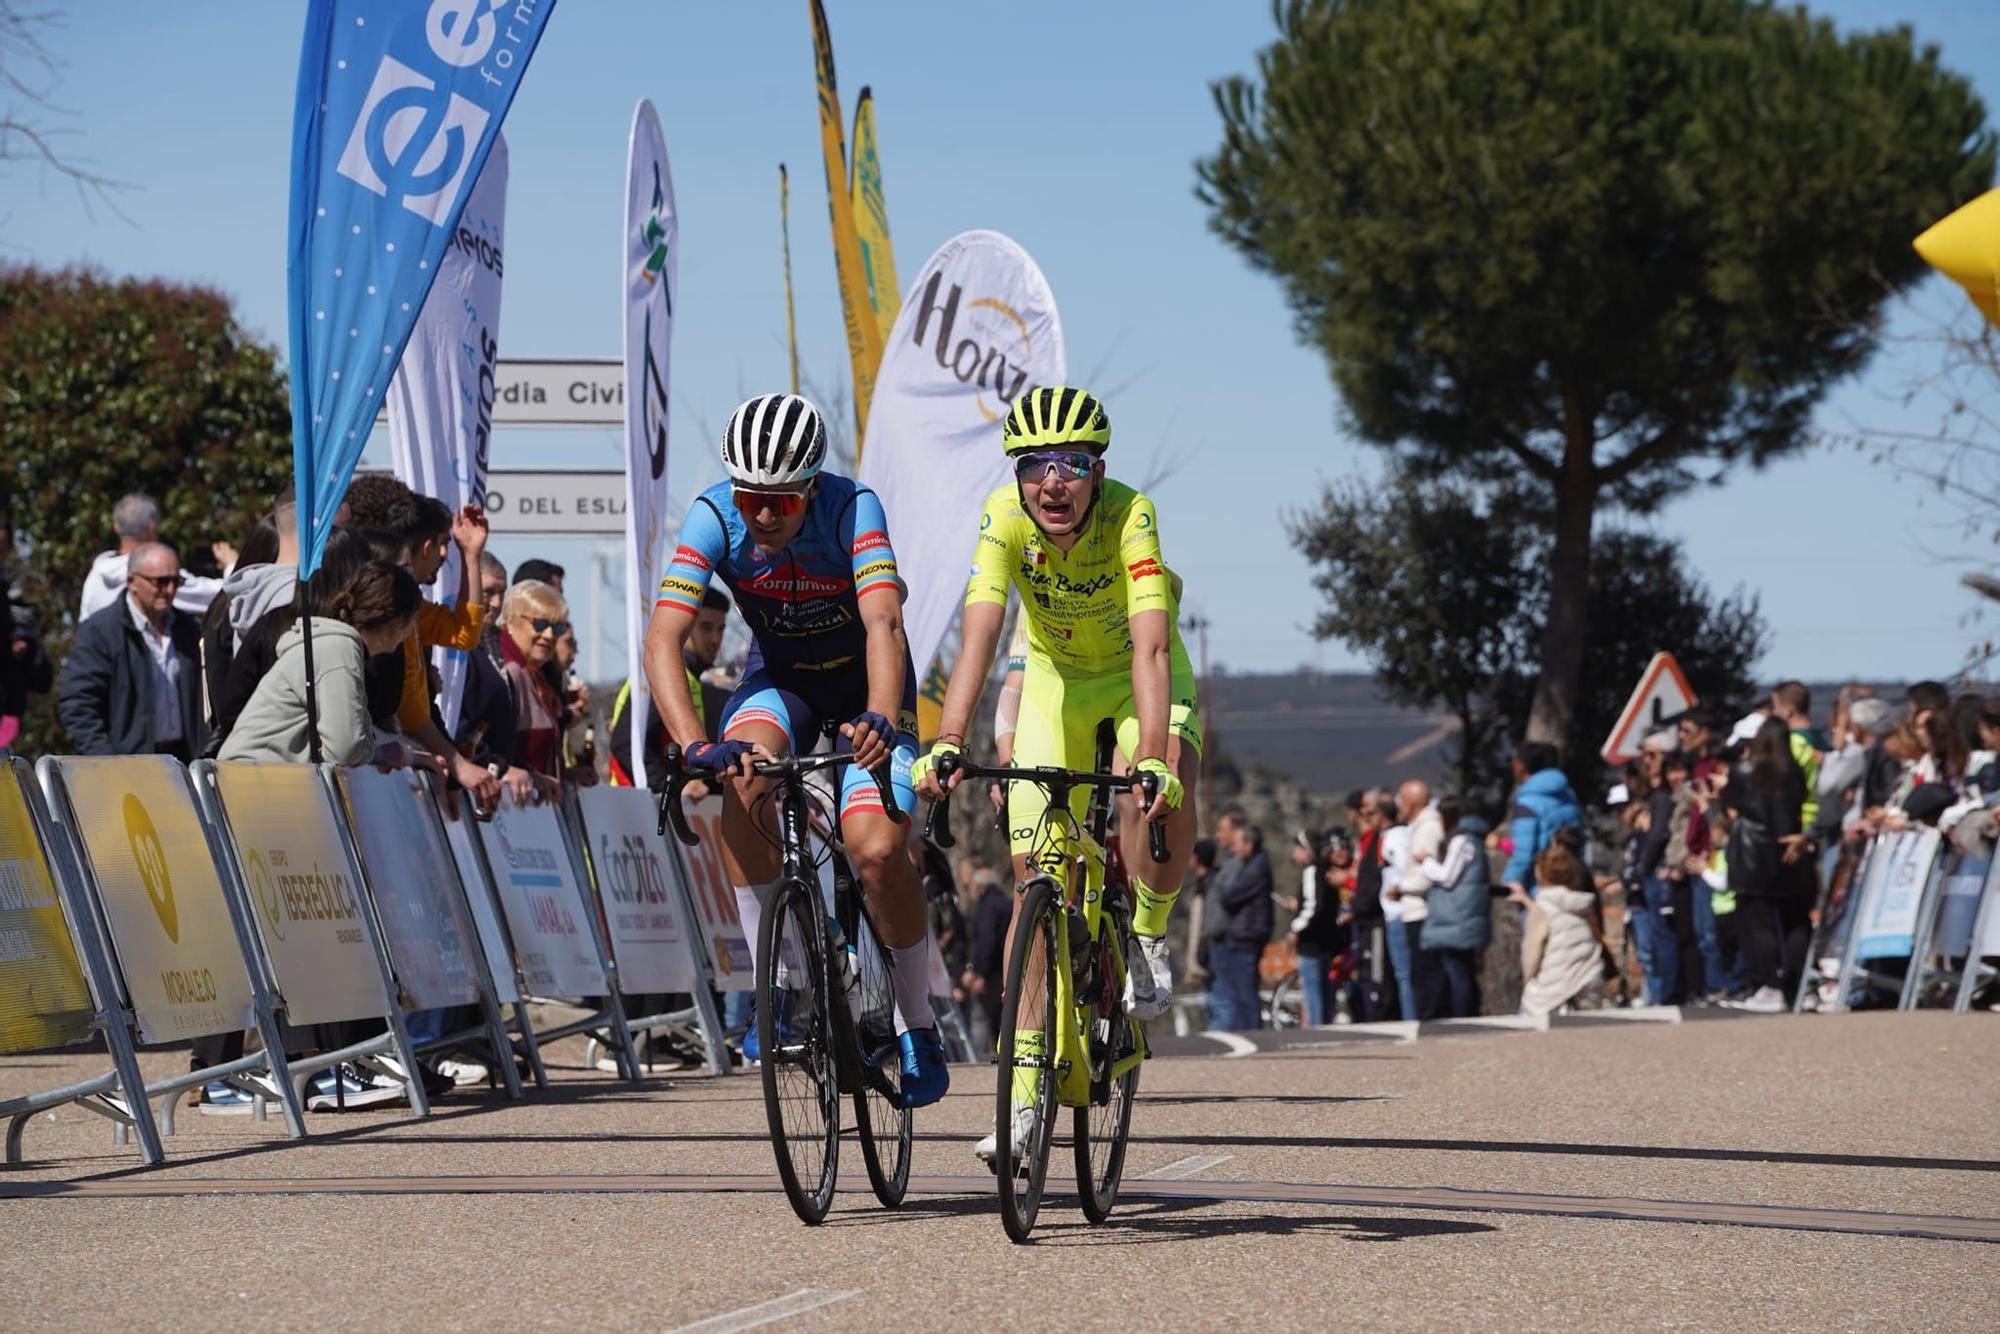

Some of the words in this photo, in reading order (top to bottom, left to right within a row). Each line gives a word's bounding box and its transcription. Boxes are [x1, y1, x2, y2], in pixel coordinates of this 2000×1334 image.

[913, 270, 1040, 405] Honz
[494, 381, 548, 404] rdia
[568, 381, 624, 405] Civi
[519, 497, 563, 515] DEL
[980, 532, 1007, 549] nova
[661, 579, 701, 597] EDWAY
[276, 861, 362, 921] IBEREÓLICA
[161, 966, 218, 1007] MORALEJO
